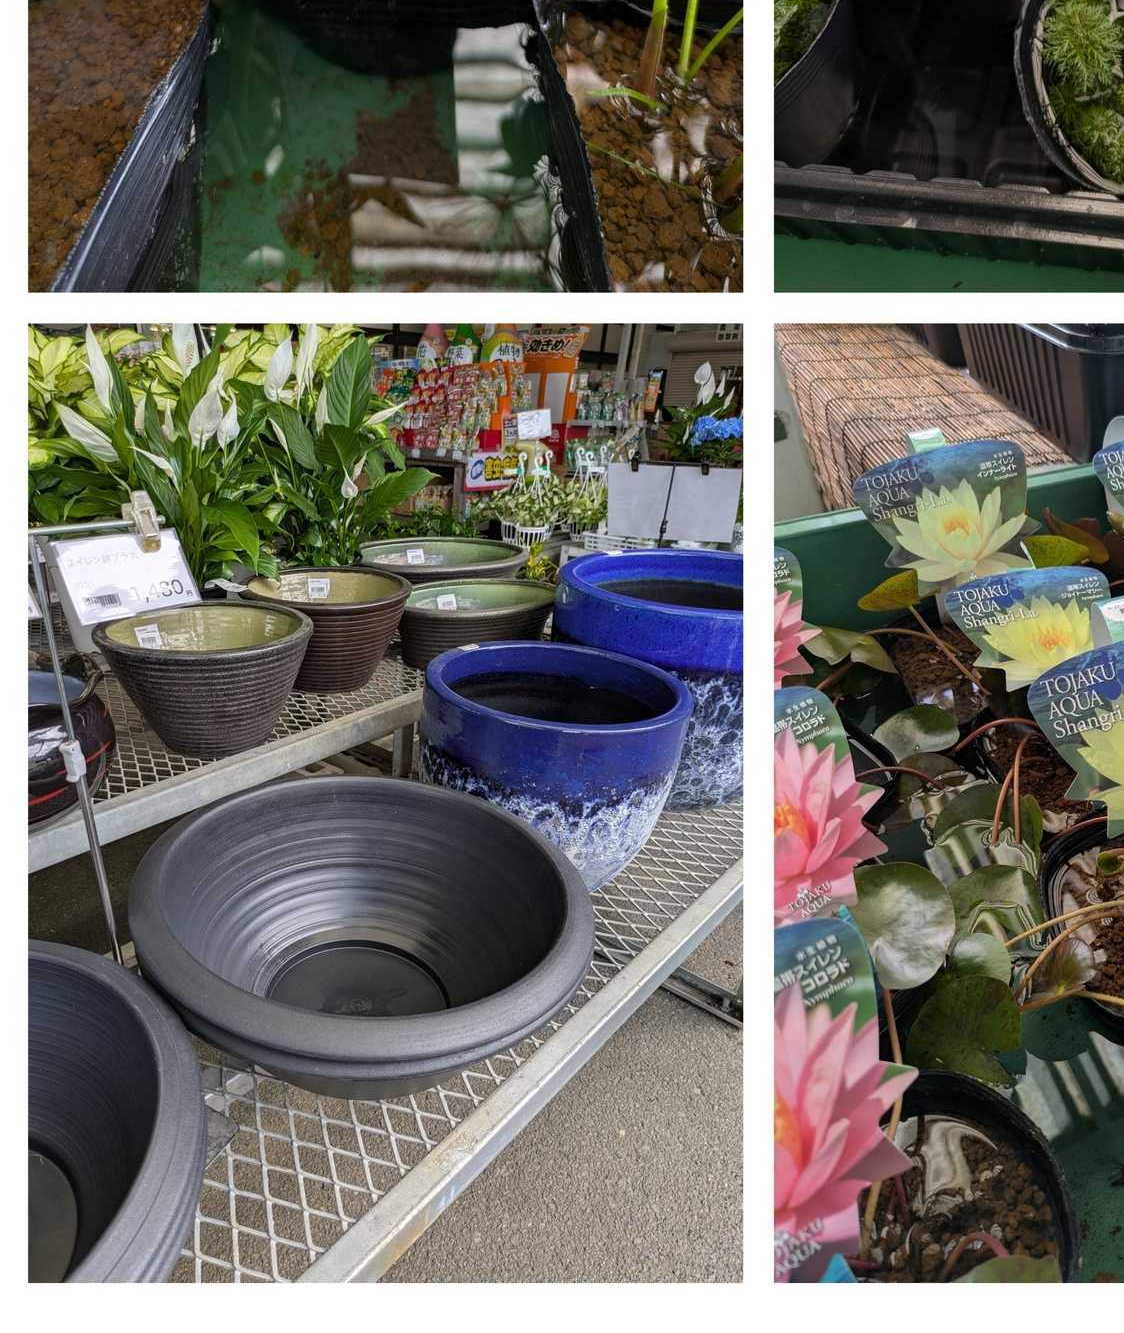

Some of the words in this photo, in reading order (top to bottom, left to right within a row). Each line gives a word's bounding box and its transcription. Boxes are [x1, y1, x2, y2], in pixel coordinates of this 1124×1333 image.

[863, 466, 920, 493] TOJAKU
[868, 490, 911, 508] AQUA
[953, 582, 1010, 605] TOJAKU
[959, 600, 1001, 618] AQUA
[1039, 661, 1117, 700] TOJAKU
[1049, 690, 1103, 721] AQUA
[796, 713, 826, 736] コロラド
[805, 958, 851, 993] コロラド
